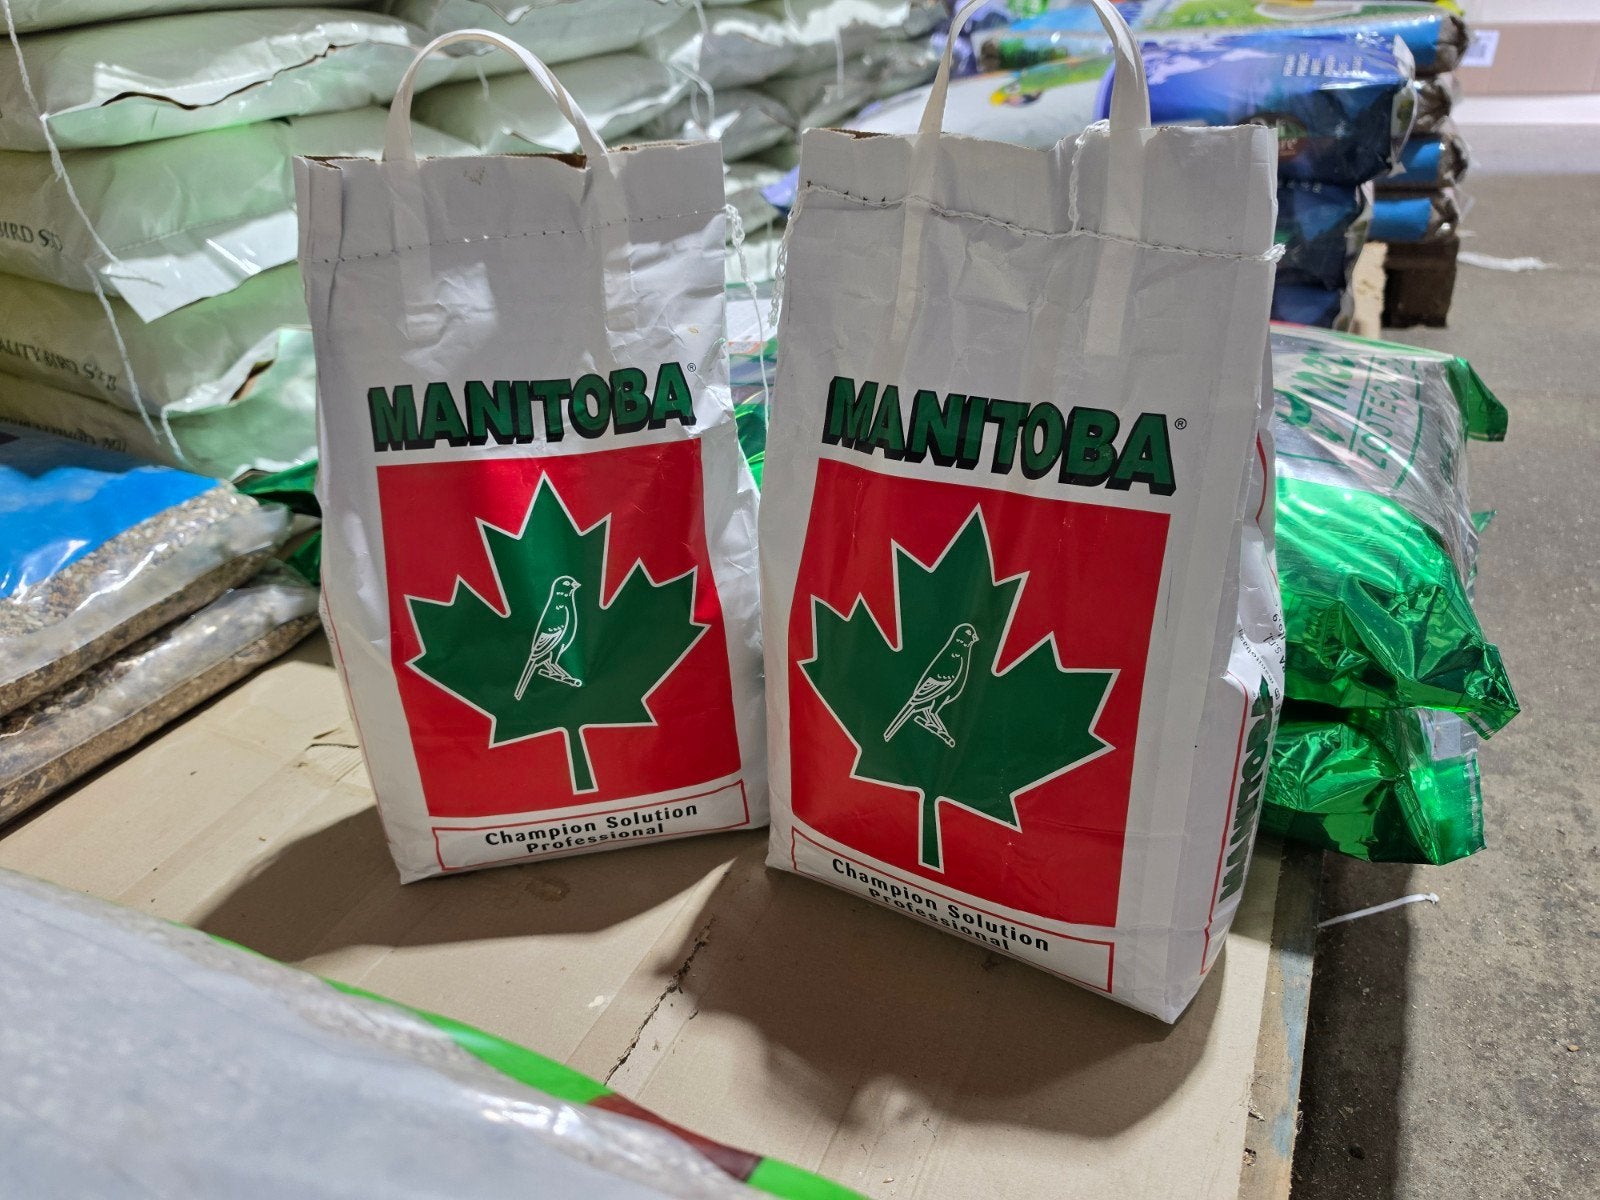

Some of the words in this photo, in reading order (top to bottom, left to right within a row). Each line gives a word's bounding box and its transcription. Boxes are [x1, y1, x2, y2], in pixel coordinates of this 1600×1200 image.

[0, 221, 35, 244] IRD
[485, 820, 597, 846] Champion
[606, 804, 698, 829] Solution
[526, 823, 664, 853] Professional
[832, 858, 938, 911] Champion
[947, 904, 1049, 952] Solution
[868, 887, 1010, 951] Professional
